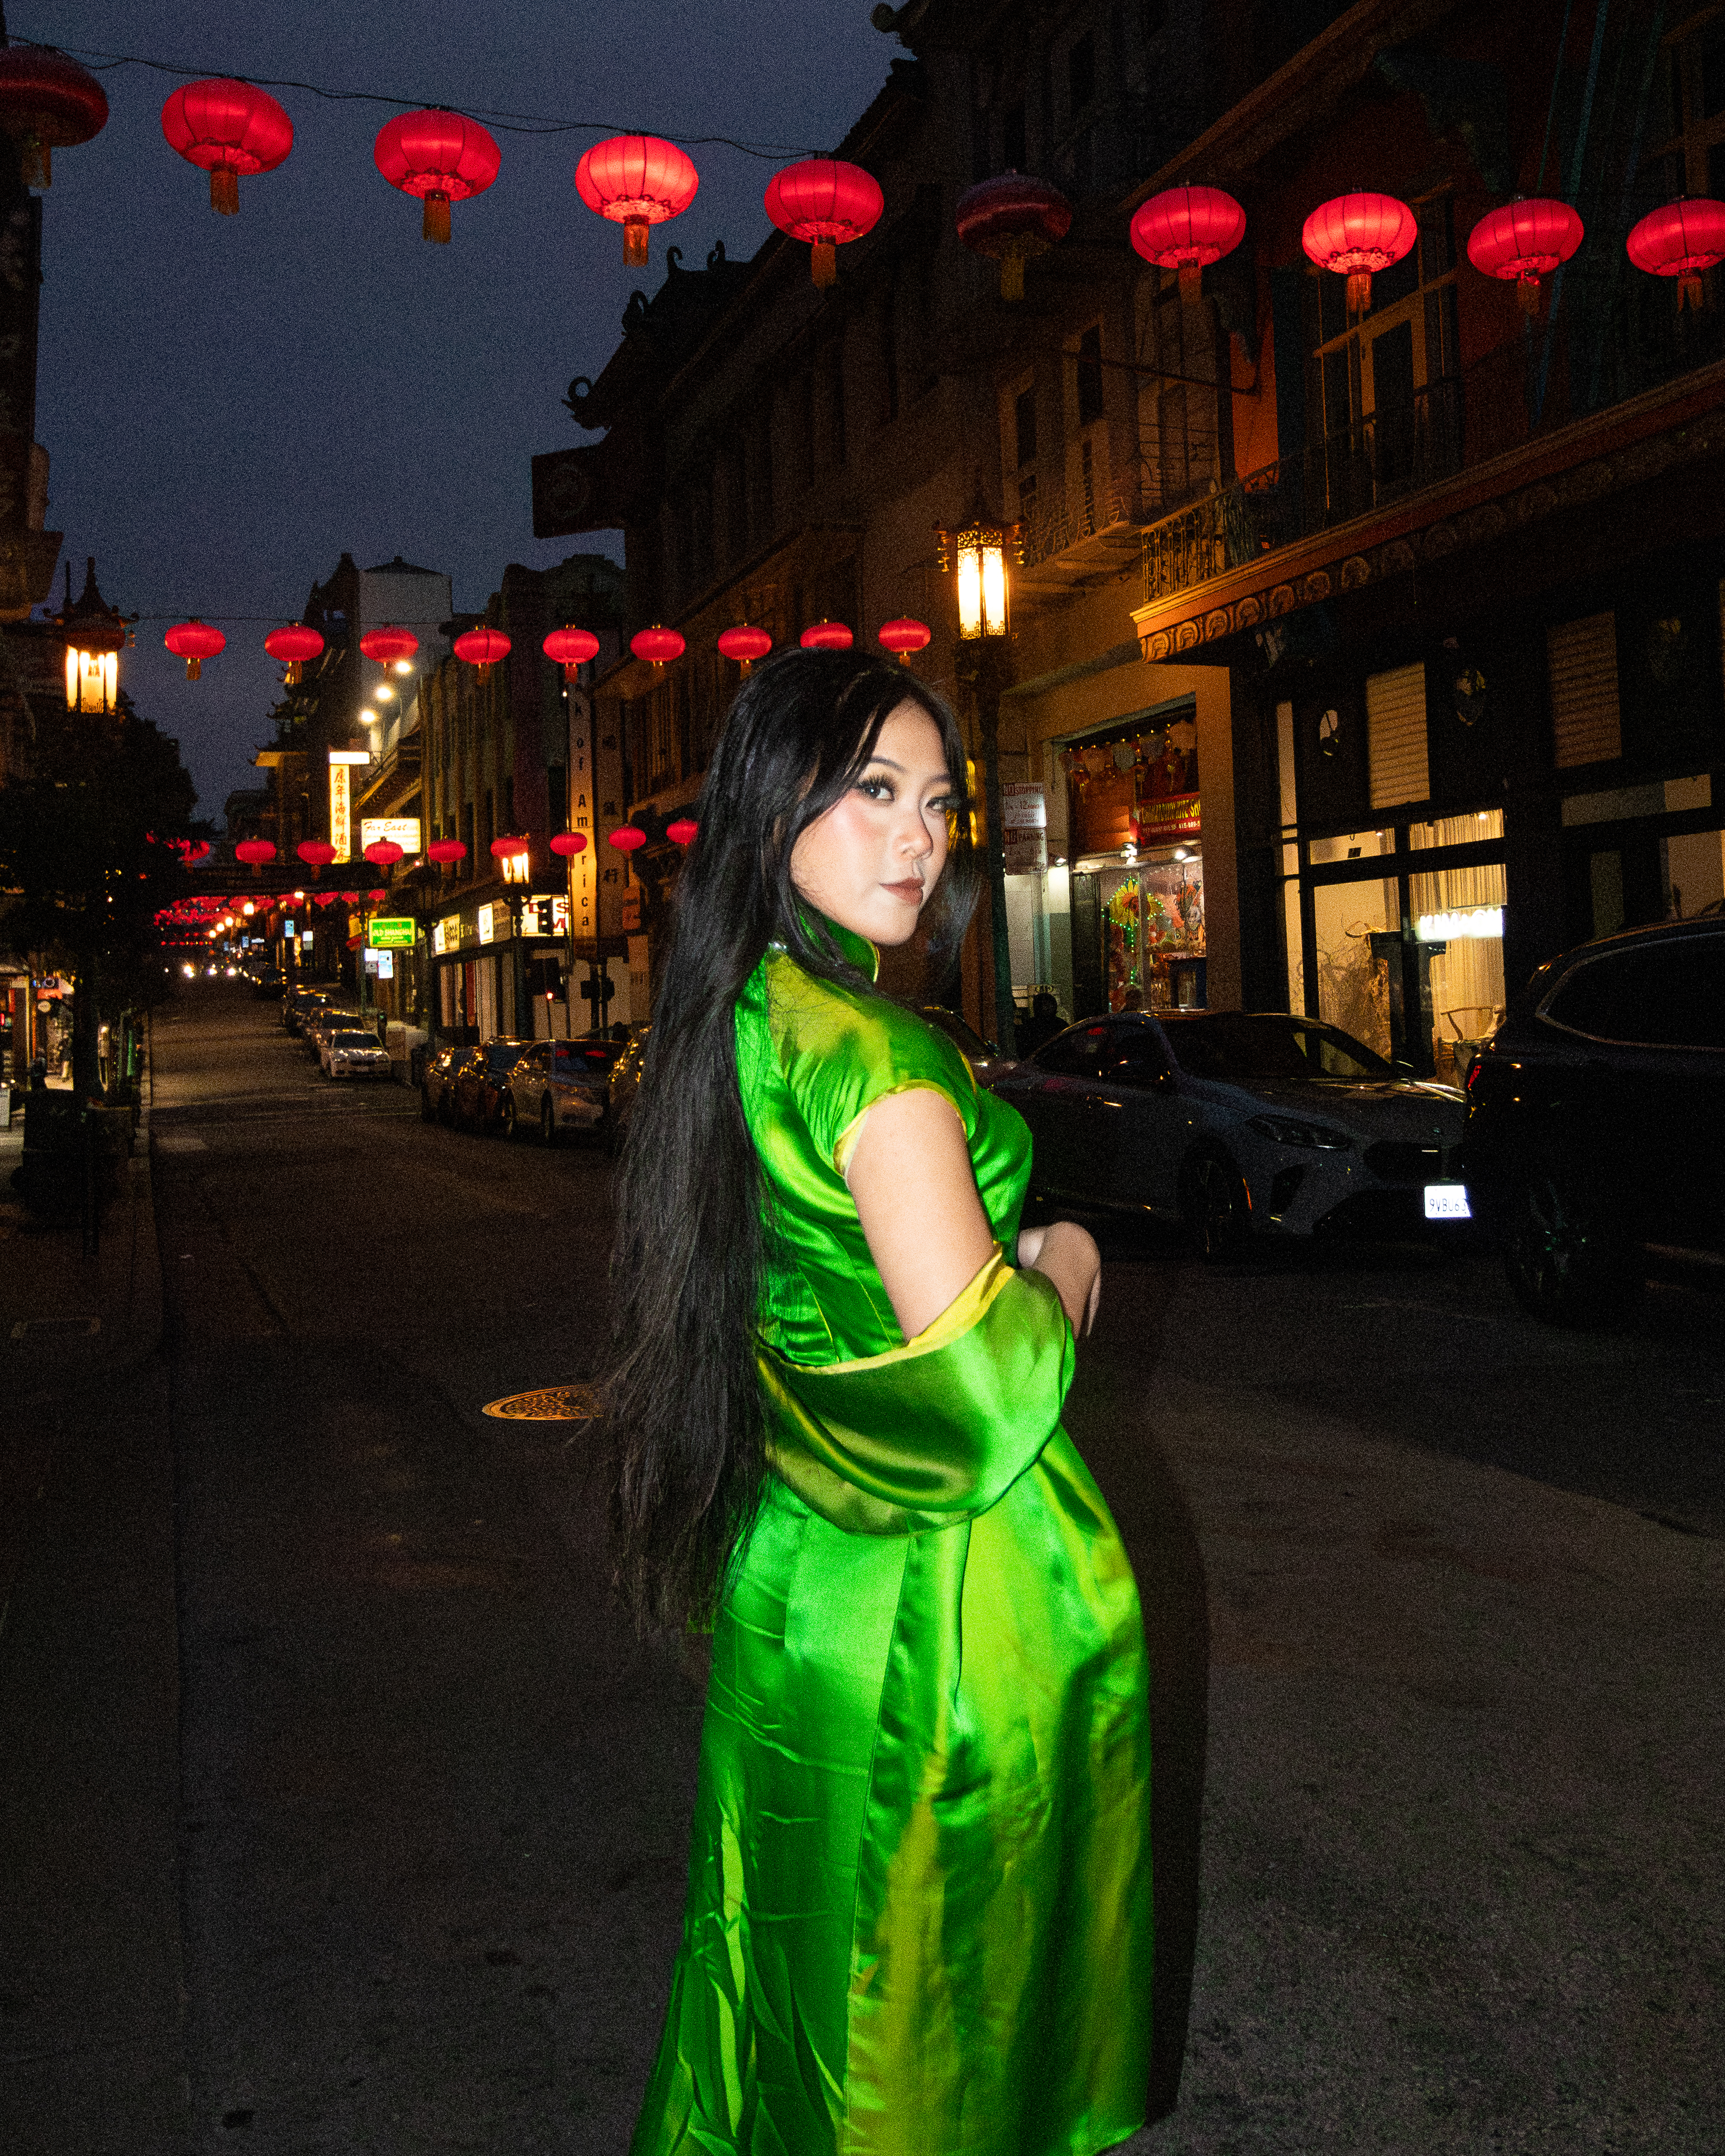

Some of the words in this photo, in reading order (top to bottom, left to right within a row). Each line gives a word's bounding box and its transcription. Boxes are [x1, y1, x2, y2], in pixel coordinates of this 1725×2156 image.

[364, 821, 380, 832] Far
[384, 821, 407, 831] East
[577, 793, 589, 927] Amrica
